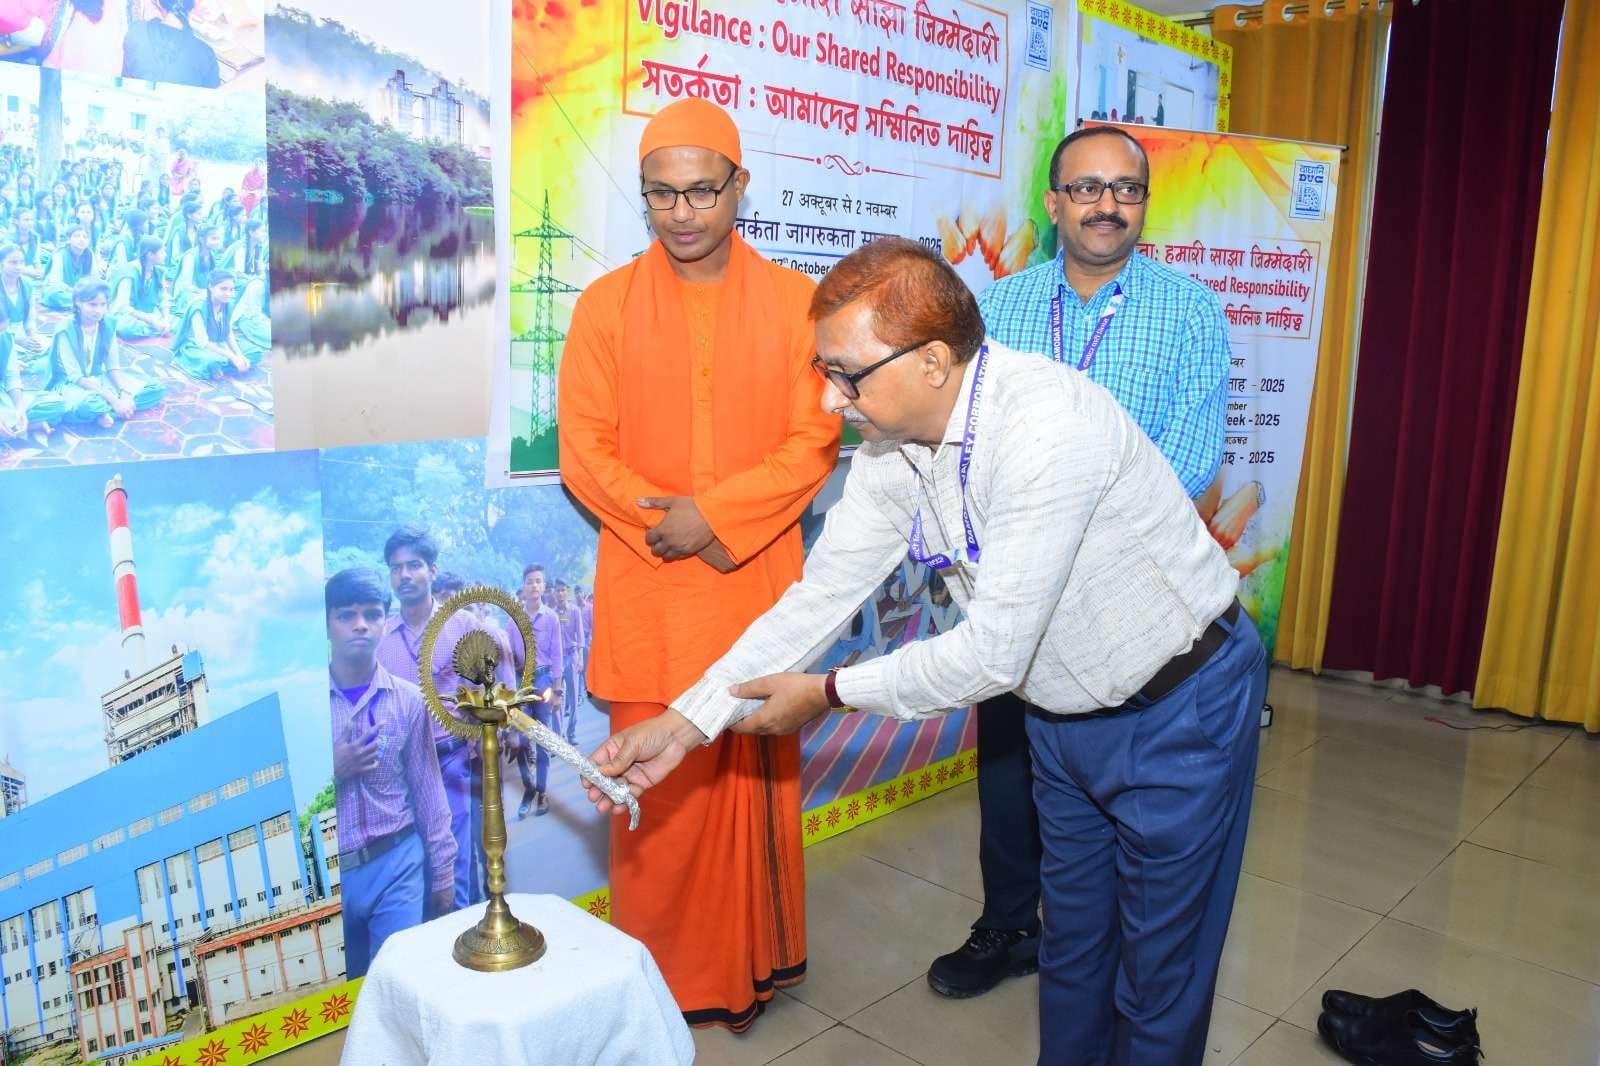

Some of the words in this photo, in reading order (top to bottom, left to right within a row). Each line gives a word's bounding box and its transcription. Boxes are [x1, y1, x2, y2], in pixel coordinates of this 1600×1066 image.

[914, 0, 999, 64] जिम्मेदारी
[772, 20, 810, 57] Our
[816, 32, 880, 76] Shared
[886, 51, 1000, 114] Responsibility
[641, 53, 741, 109] সতর্কতা
[764, 85, 859, 136] আমাদের
[865, 99, 941, 146] সম্মিলিত
[947, 118, 993, 164] দায়িত্ব
[782, 190, 793, 207] 27
[799, 193, 838, 216] अक्टूबर
[842, 194, 851, 214] से
[856, 200, 861, 215] 2
[865, 202, 898, 219] नवम्बर
[736, 211, 780, 241] तर्कता
[785, 223, 855, 248] जागरुकता
[790, 259, 830, 275] October
[1165, 240, 1206, 265] हमारी
[1210, 248, 1245, 271] साझा
[1251, 244, 1312, 272] जिम्मेदारी
[1190, 273, 1227, 292] ared
[1230, 276, 1310, 302] Responsibility
[1224, 303, 1262, 326] ম্মিলিত
[1266, 306, 1303, 331] দায়িত্ব
[1260, 378, 1285, 393] 2025
[1226, 413, 1246, 426] eek
[1255, 414, 1280, 426] 2025
[1227, 401, 1248, 411] mber
[1249, 451, 1275, 464] 2025
[963, 508, 976, 546] DAMO
